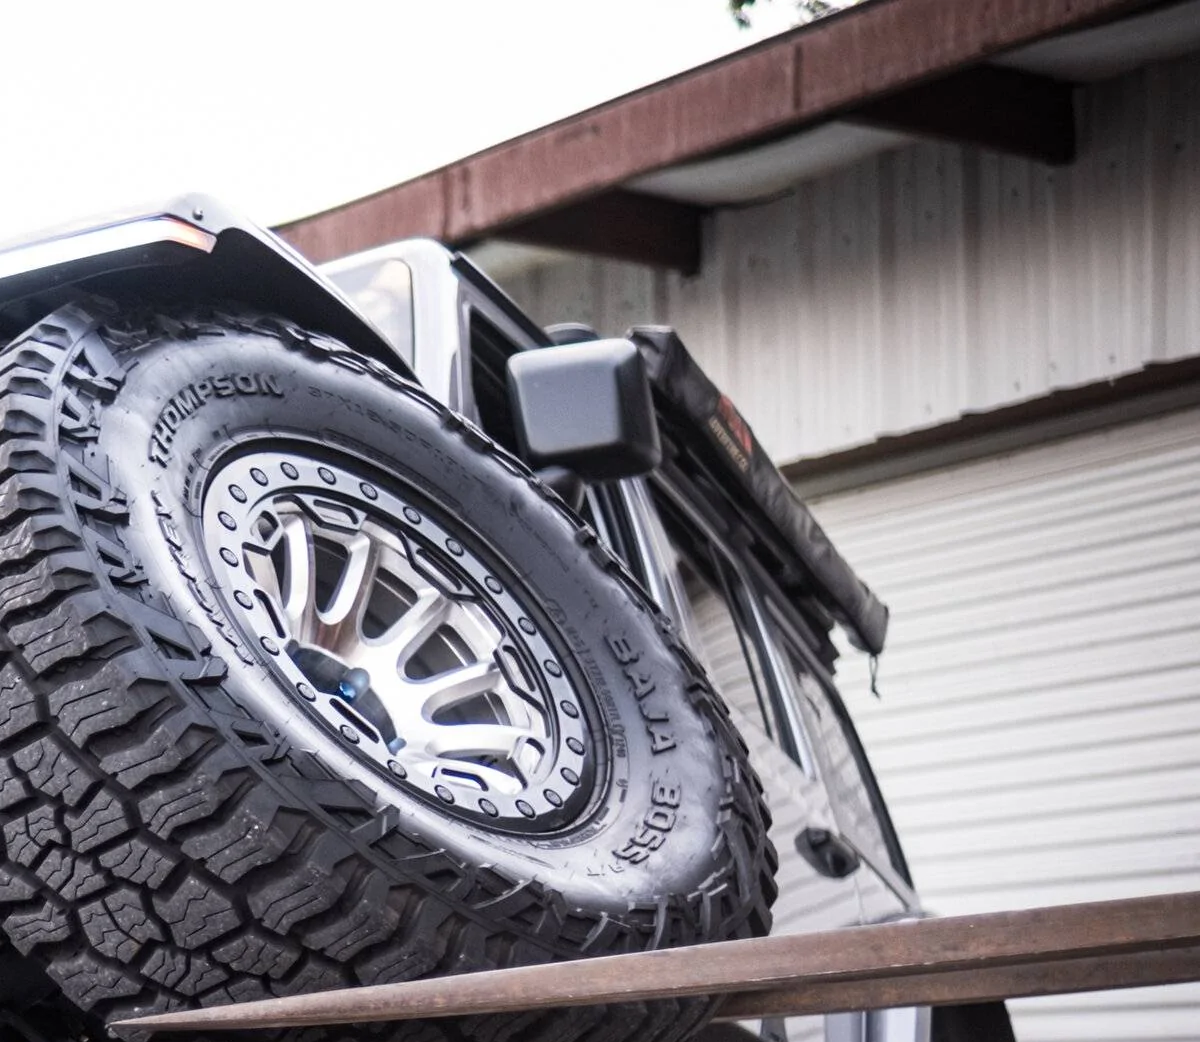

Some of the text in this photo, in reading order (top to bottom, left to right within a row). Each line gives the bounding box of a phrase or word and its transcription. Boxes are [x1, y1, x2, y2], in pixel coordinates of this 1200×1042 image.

[149, 373, 285, 469] THOMPSON
[603, 634, 677, 756] BAJA
[612, 779, 681, 864] BOSS
